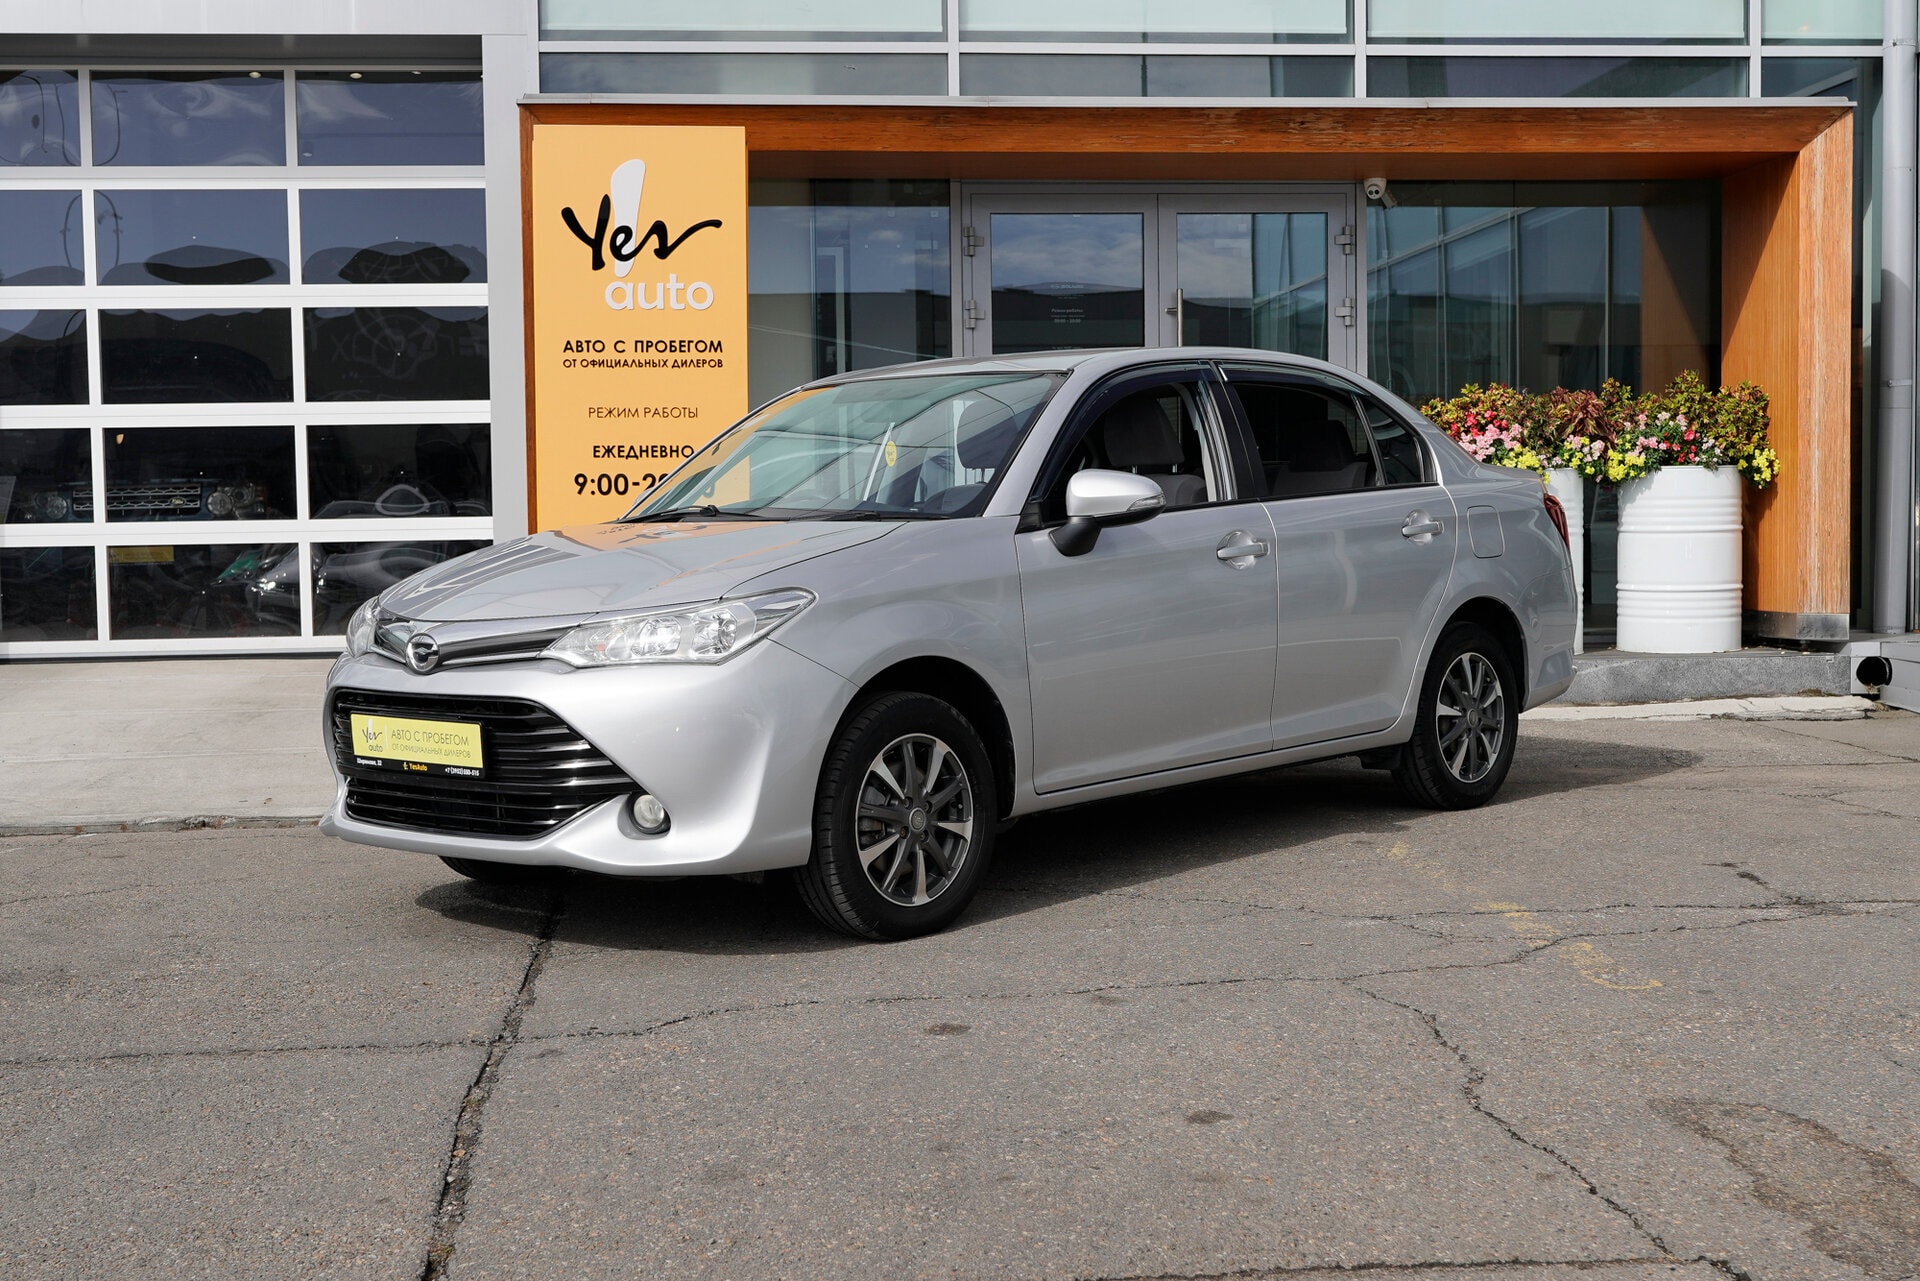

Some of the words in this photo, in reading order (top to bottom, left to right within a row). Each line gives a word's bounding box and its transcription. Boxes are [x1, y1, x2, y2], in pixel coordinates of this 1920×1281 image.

[605, 274, 714, 310] auto
[563, 340, 606, 353] АВТО
[613, 340, 626, 353] С
[634, 340, 723, 353] ПРОБЕГОМ
[562, 359, 577, 368] ОТ
[580, 359, 669, 369] ОФИЦИАЛЬНЫХ
[671, 359, 724, 369] ДИЛЕРОВ
[588, 407, 640, 418] РЕЖИМ
[643, 407, 698, 418] РАБОТЫ
[592, 445, 695, 460] ЕЖЕДНЕВНО
[574, 473, 669, 495] 9:00-2
[391, 729, 412, 741] АВТО
[413, 731, 421, 742] С
[422, 731, 470, 746] ПРОБЕГОМ
[368, 744, 383, 753] auto
